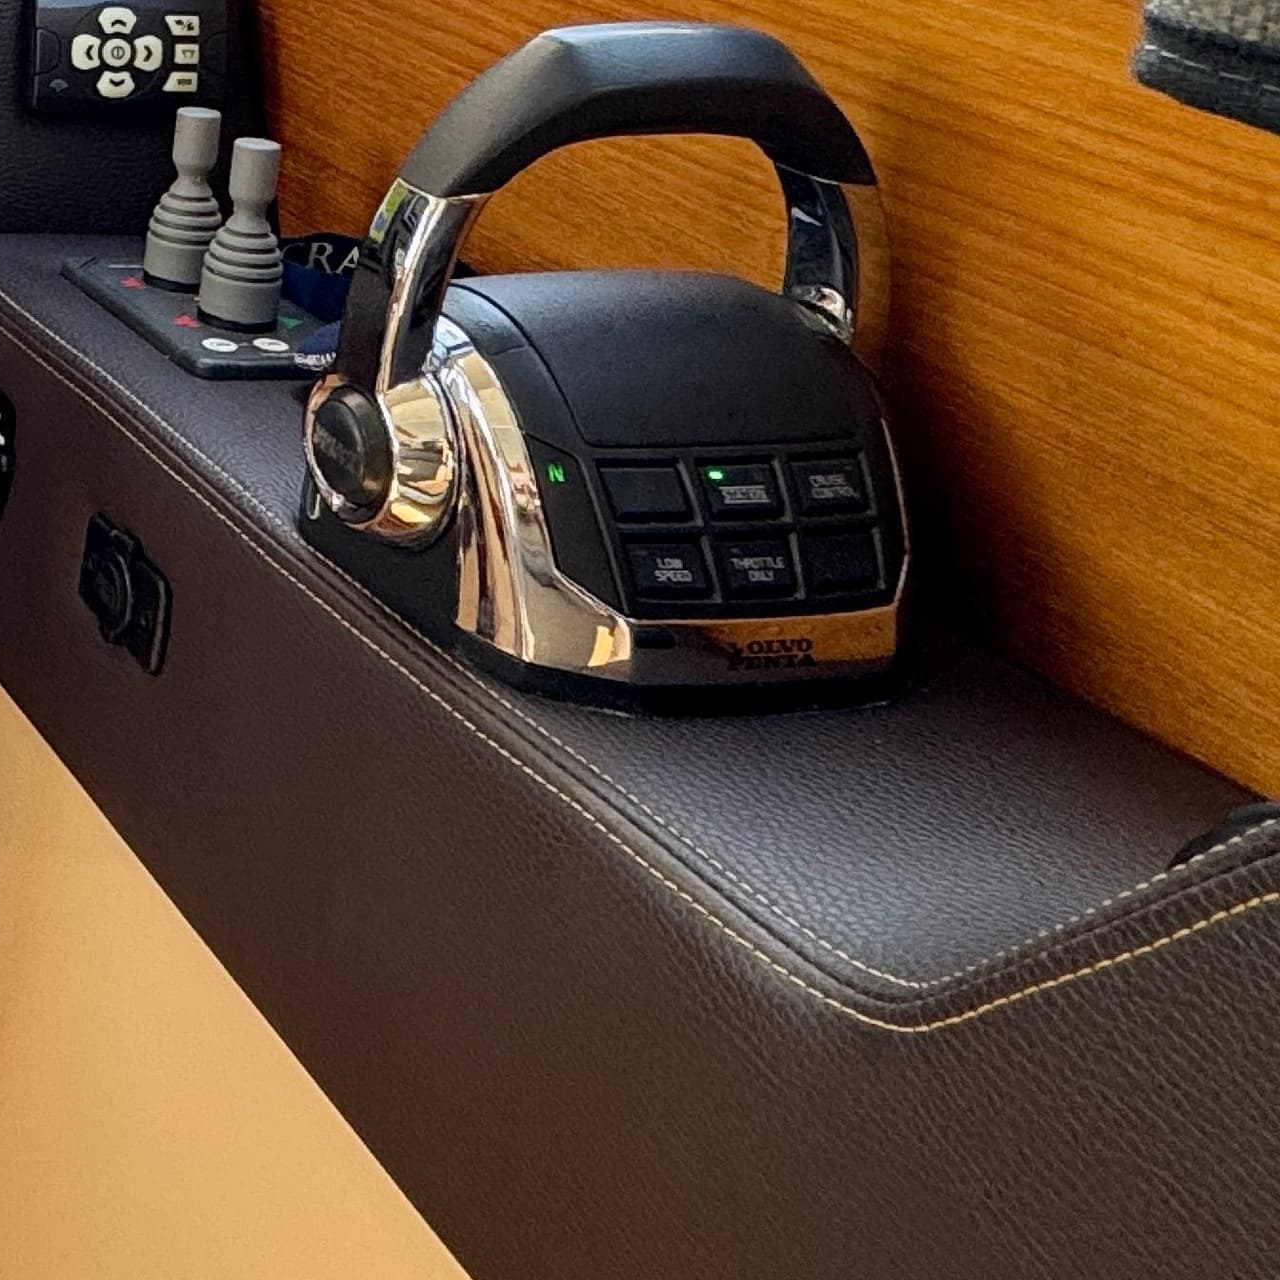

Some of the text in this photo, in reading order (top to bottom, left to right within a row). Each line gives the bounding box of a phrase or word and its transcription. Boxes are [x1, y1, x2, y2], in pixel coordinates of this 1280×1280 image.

[548, 463, 565, 482] N
[809, 474, 848, 487] CRUISE
[811, 487, 861, 500] CONTROL
[730, 556, 786, 569] THROTTLE
[653, 570, 693, 582] SPEED
[724, 636, 814, 657] VOLVO
[728, 654, 817, 670] PENTA
